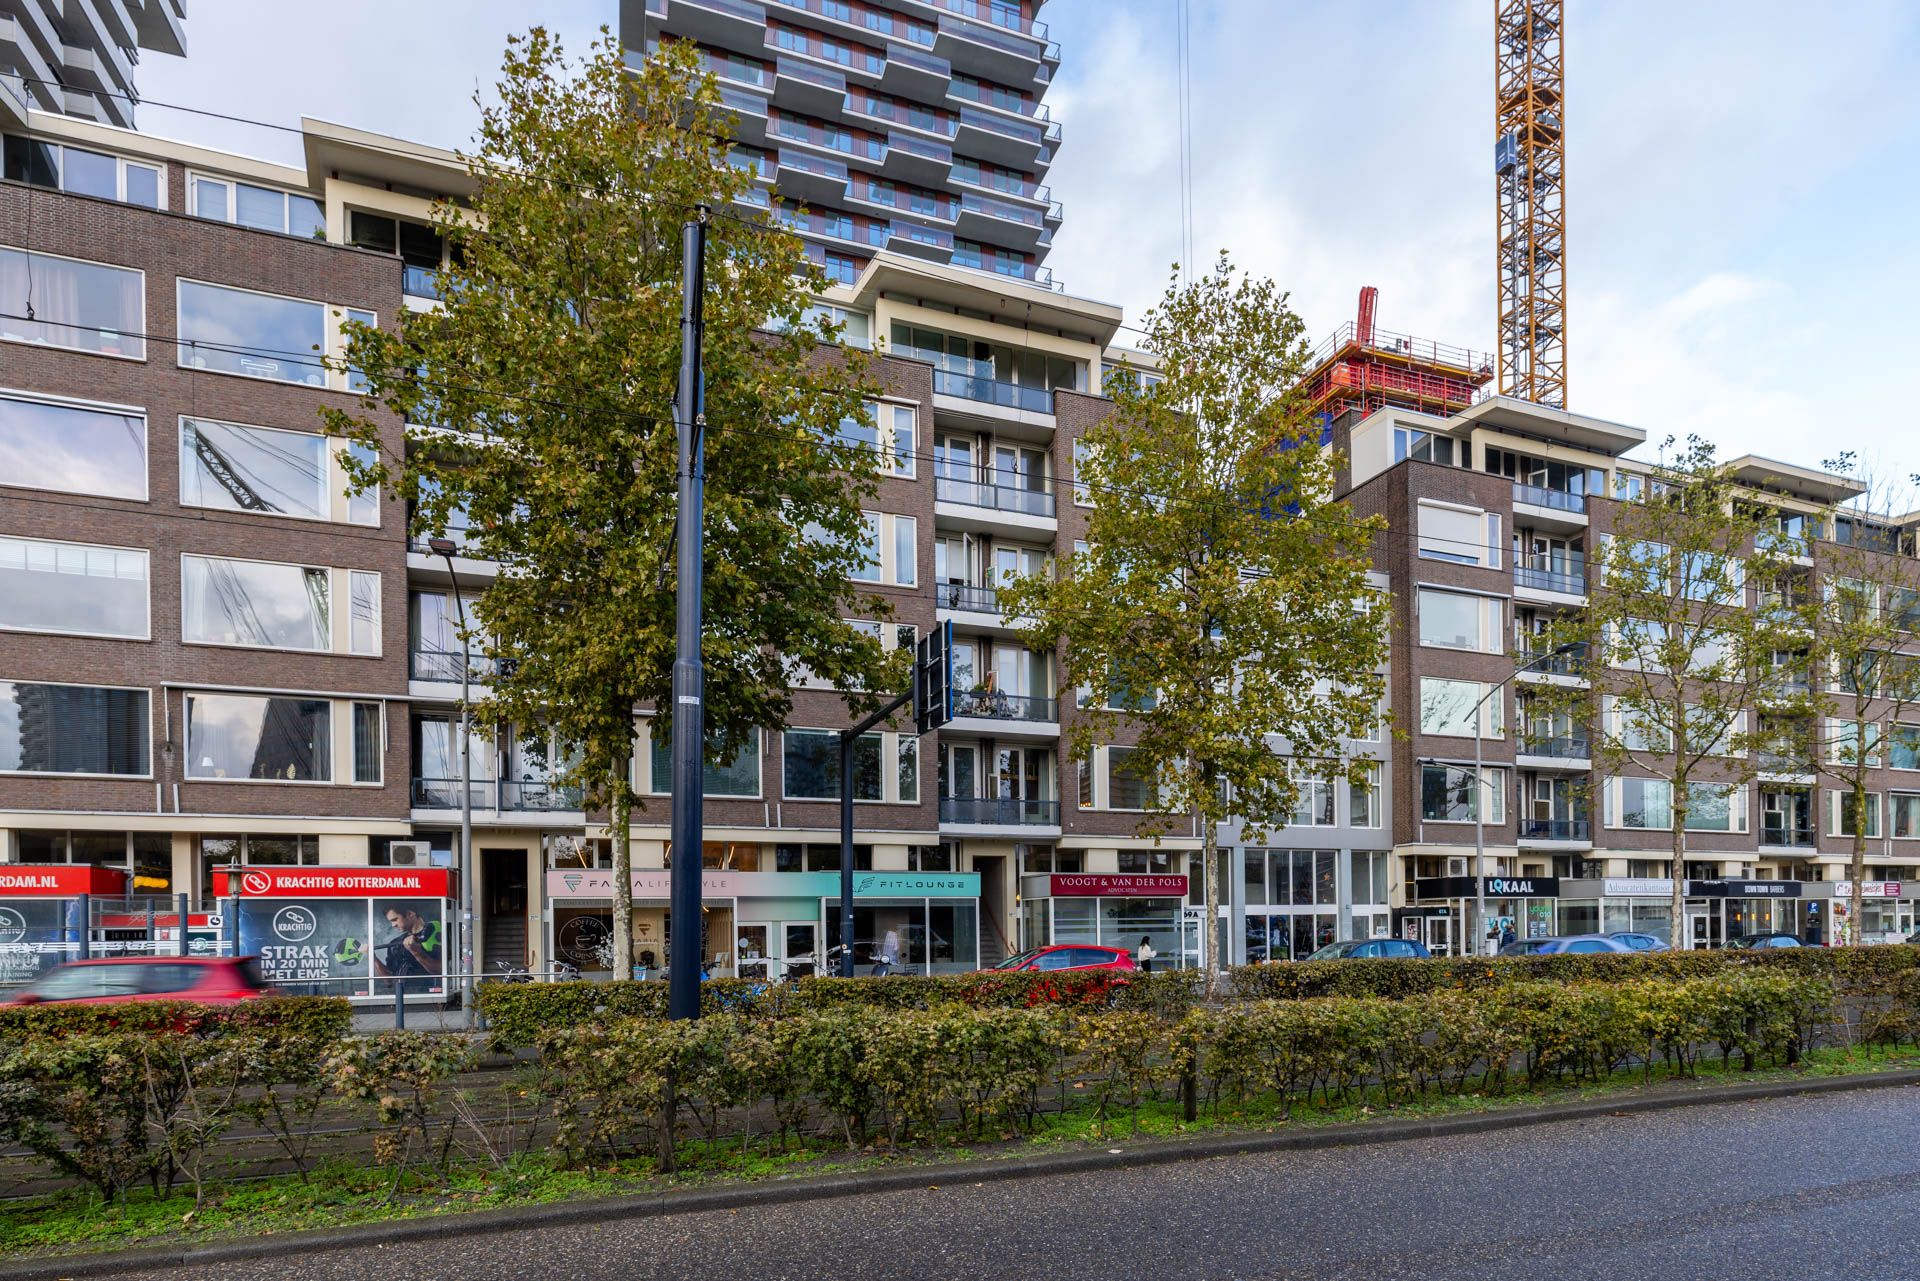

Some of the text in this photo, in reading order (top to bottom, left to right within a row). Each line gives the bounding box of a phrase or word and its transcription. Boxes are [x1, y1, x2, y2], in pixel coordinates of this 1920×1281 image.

[276, 877, 421, 888] KRACHTIG ROTTERDAM.NL
[880, 881, 965, 889] FITLOUNGE
[1059, 877, 1182, 886] VOOGT & VAN DER POLS
[1489, 879, 1534, 894] LOKAAL
[278, 923, 313, 932] KRACHTIG
[570, 919, 600, 929] COFFEE
[260, 945, 329, 960] STRAK
[260, 959, 329, 969] IN 20 MIN
[261, 969, 329, 980] MET EMS
